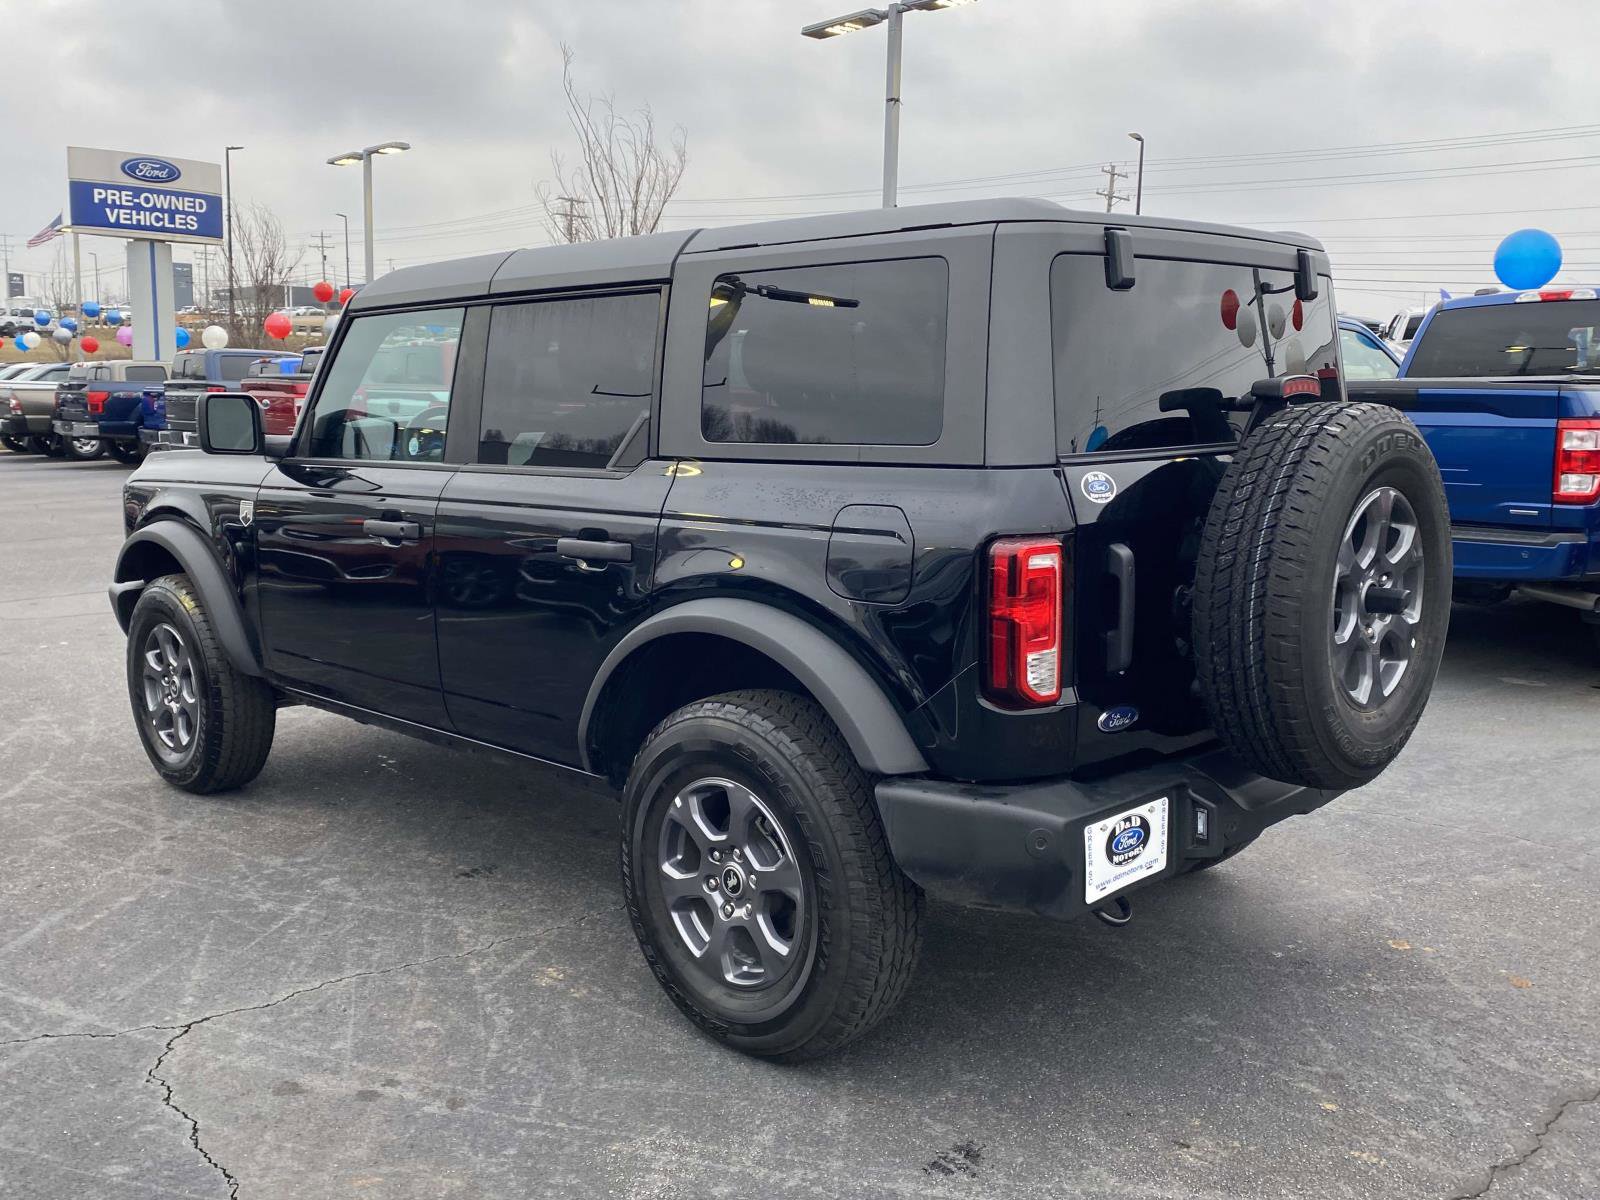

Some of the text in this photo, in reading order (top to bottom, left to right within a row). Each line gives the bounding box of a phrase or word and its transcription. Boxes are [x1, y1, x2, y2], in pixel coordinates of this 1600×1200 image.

[135, 162, 168, 179] Ford
[93, 188, 207, 213] PRE-OWNED
[105, 207, 198, 230] VEHICLES
[1109, 712, 1131, 728] Ford
[1115, 816, 1140, 836] D&D
[1118, 831, 1139, 850] Ford
